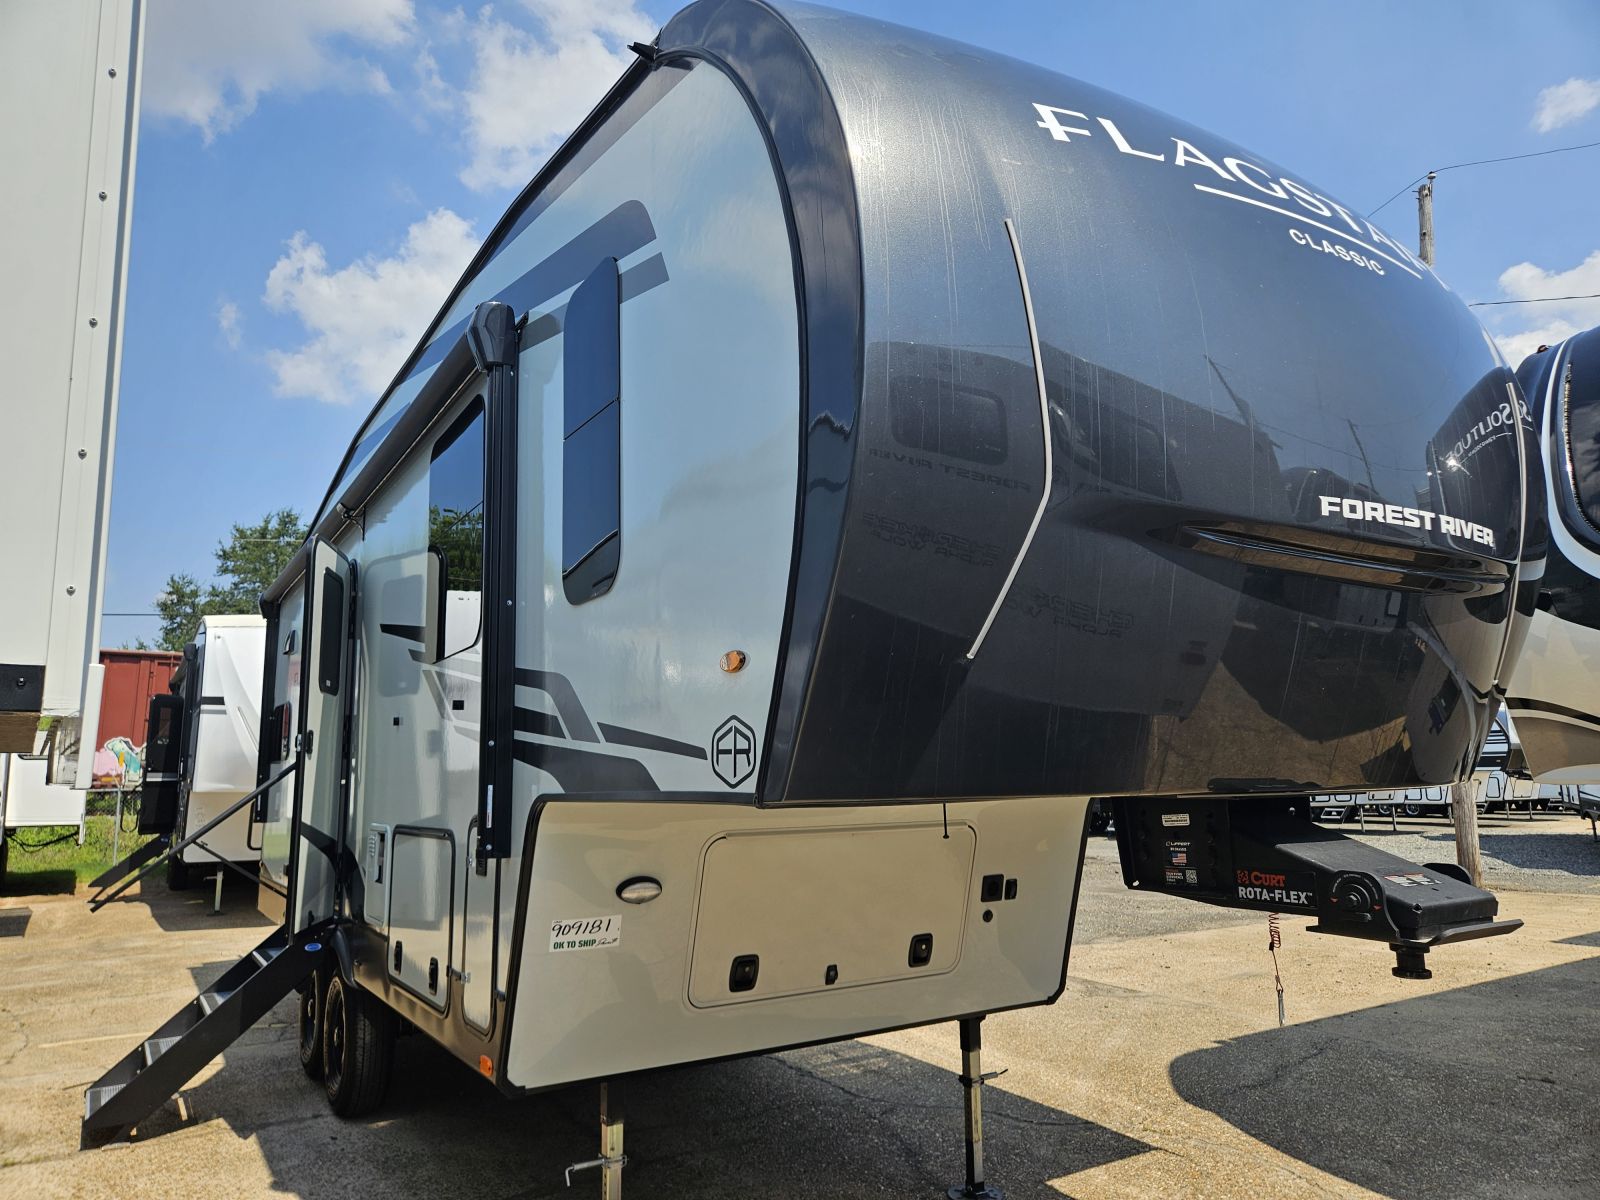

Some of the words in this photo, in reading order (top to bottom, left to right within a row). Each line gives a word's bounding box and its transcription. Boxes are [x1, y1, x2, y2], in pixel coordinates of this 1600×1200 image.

[1288, 228, 1386, 276] CLASSIC
[1319, 495, 1436, 531] FOREST
[1438, 514, 1495, 547] RIVER
[552, 918, 612, 938] 909181
[553, 941, 564, 950] OK
[566, 940, 576, 949] TO
[578, 938, 597, 948] SHIP
